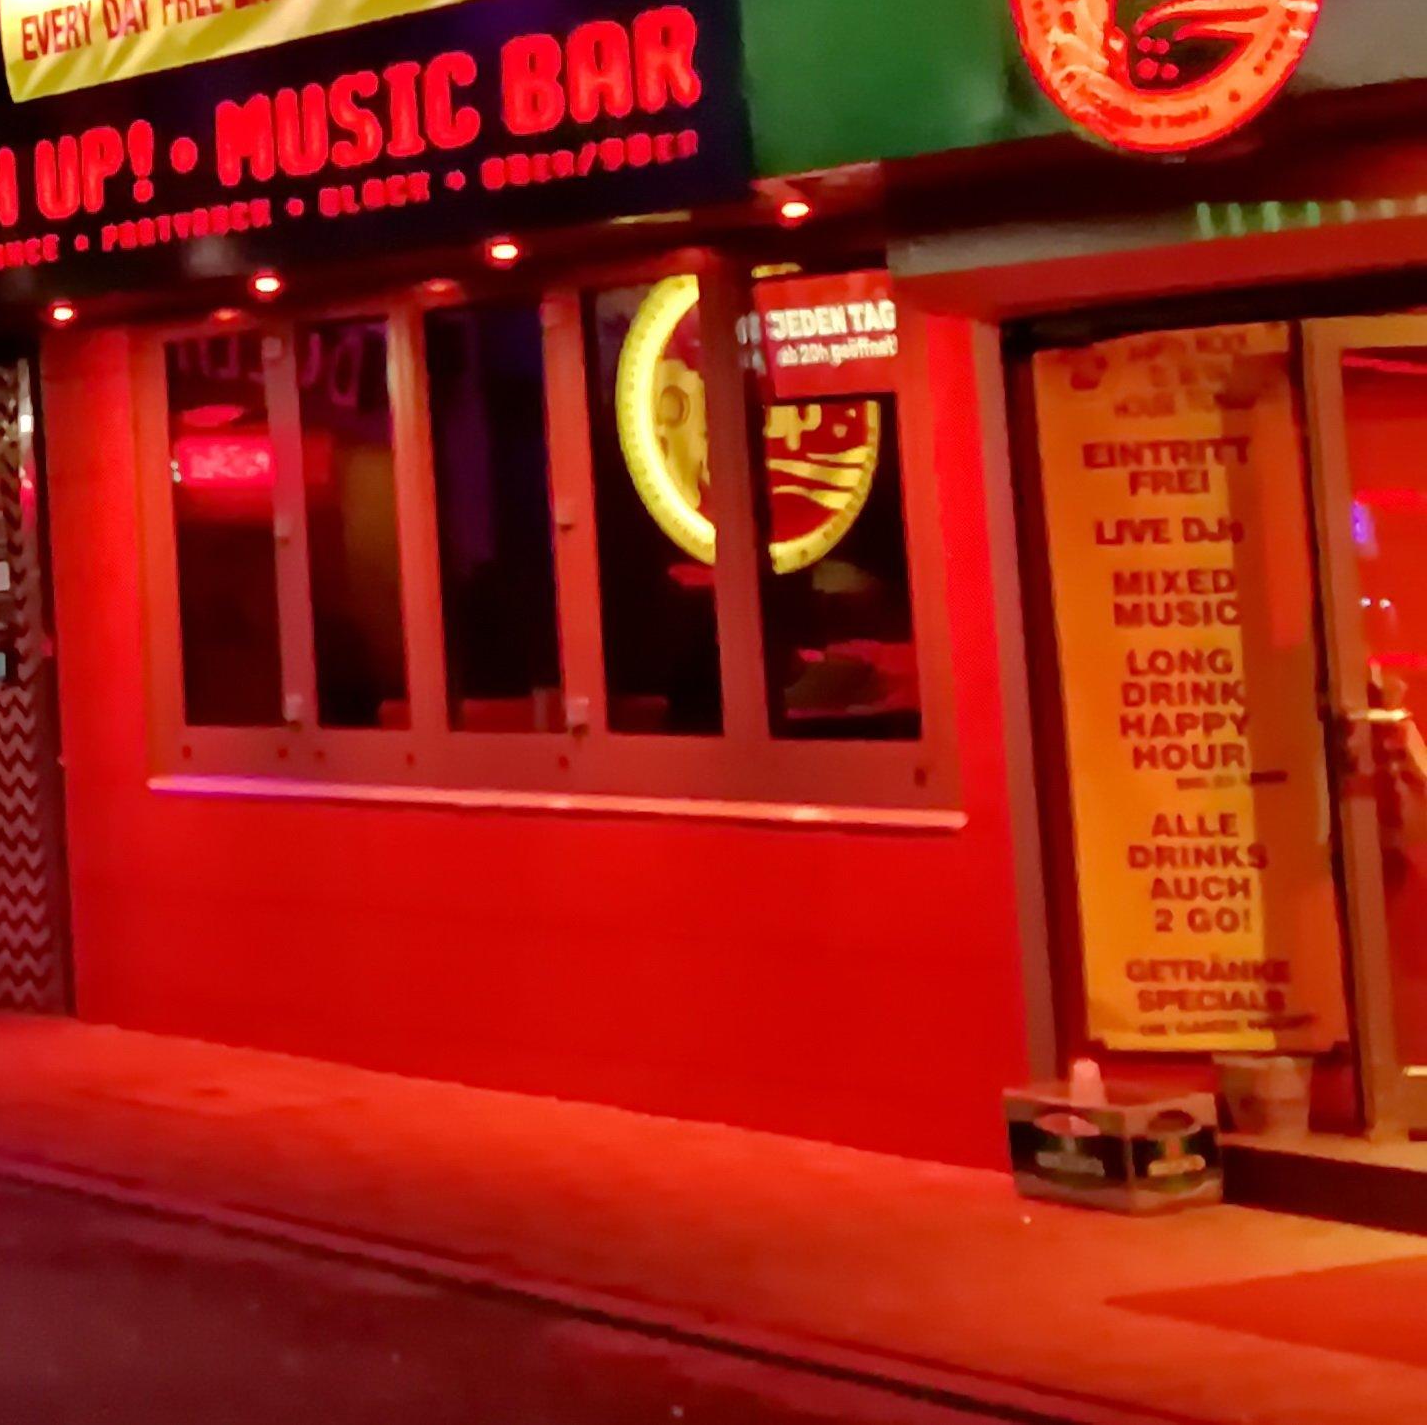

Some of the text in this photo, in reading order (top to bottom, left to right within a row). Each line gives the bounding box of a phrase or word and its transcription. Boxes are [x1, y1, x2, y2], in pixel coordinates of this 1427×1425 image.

[21, 4, 93, 61] EVERY
[35, 119, 154, 219] UP!
[215, 51, 481, 187] MUSIC
[500, 5, 702, 135] BAR
[765, 298, 896, 342] JEDEN TAG
[1082, 436, 1252, 469] EINTRITT
[1129, 468, 1210, 496] FREI
[1095, 517, 1171, 546] LIVE
[1112, 568, 1239, 597] MIXED
[1113, 599, 1242, 629] MUSIC
[1126, 647, 1234, 676] LONG
[1121, 679, 1247, 707] DRINK
[1119, 711, 1251, 739] HAPPY
[1132, 743, 1247, 771] HOUR
[1151, 812, 1240, 838] ALLE
[1127, 842, 1269, 870] DRINKS
[1150, 876, 1252, 902] AUCH
[1154, 907, 1173, 933] 2
